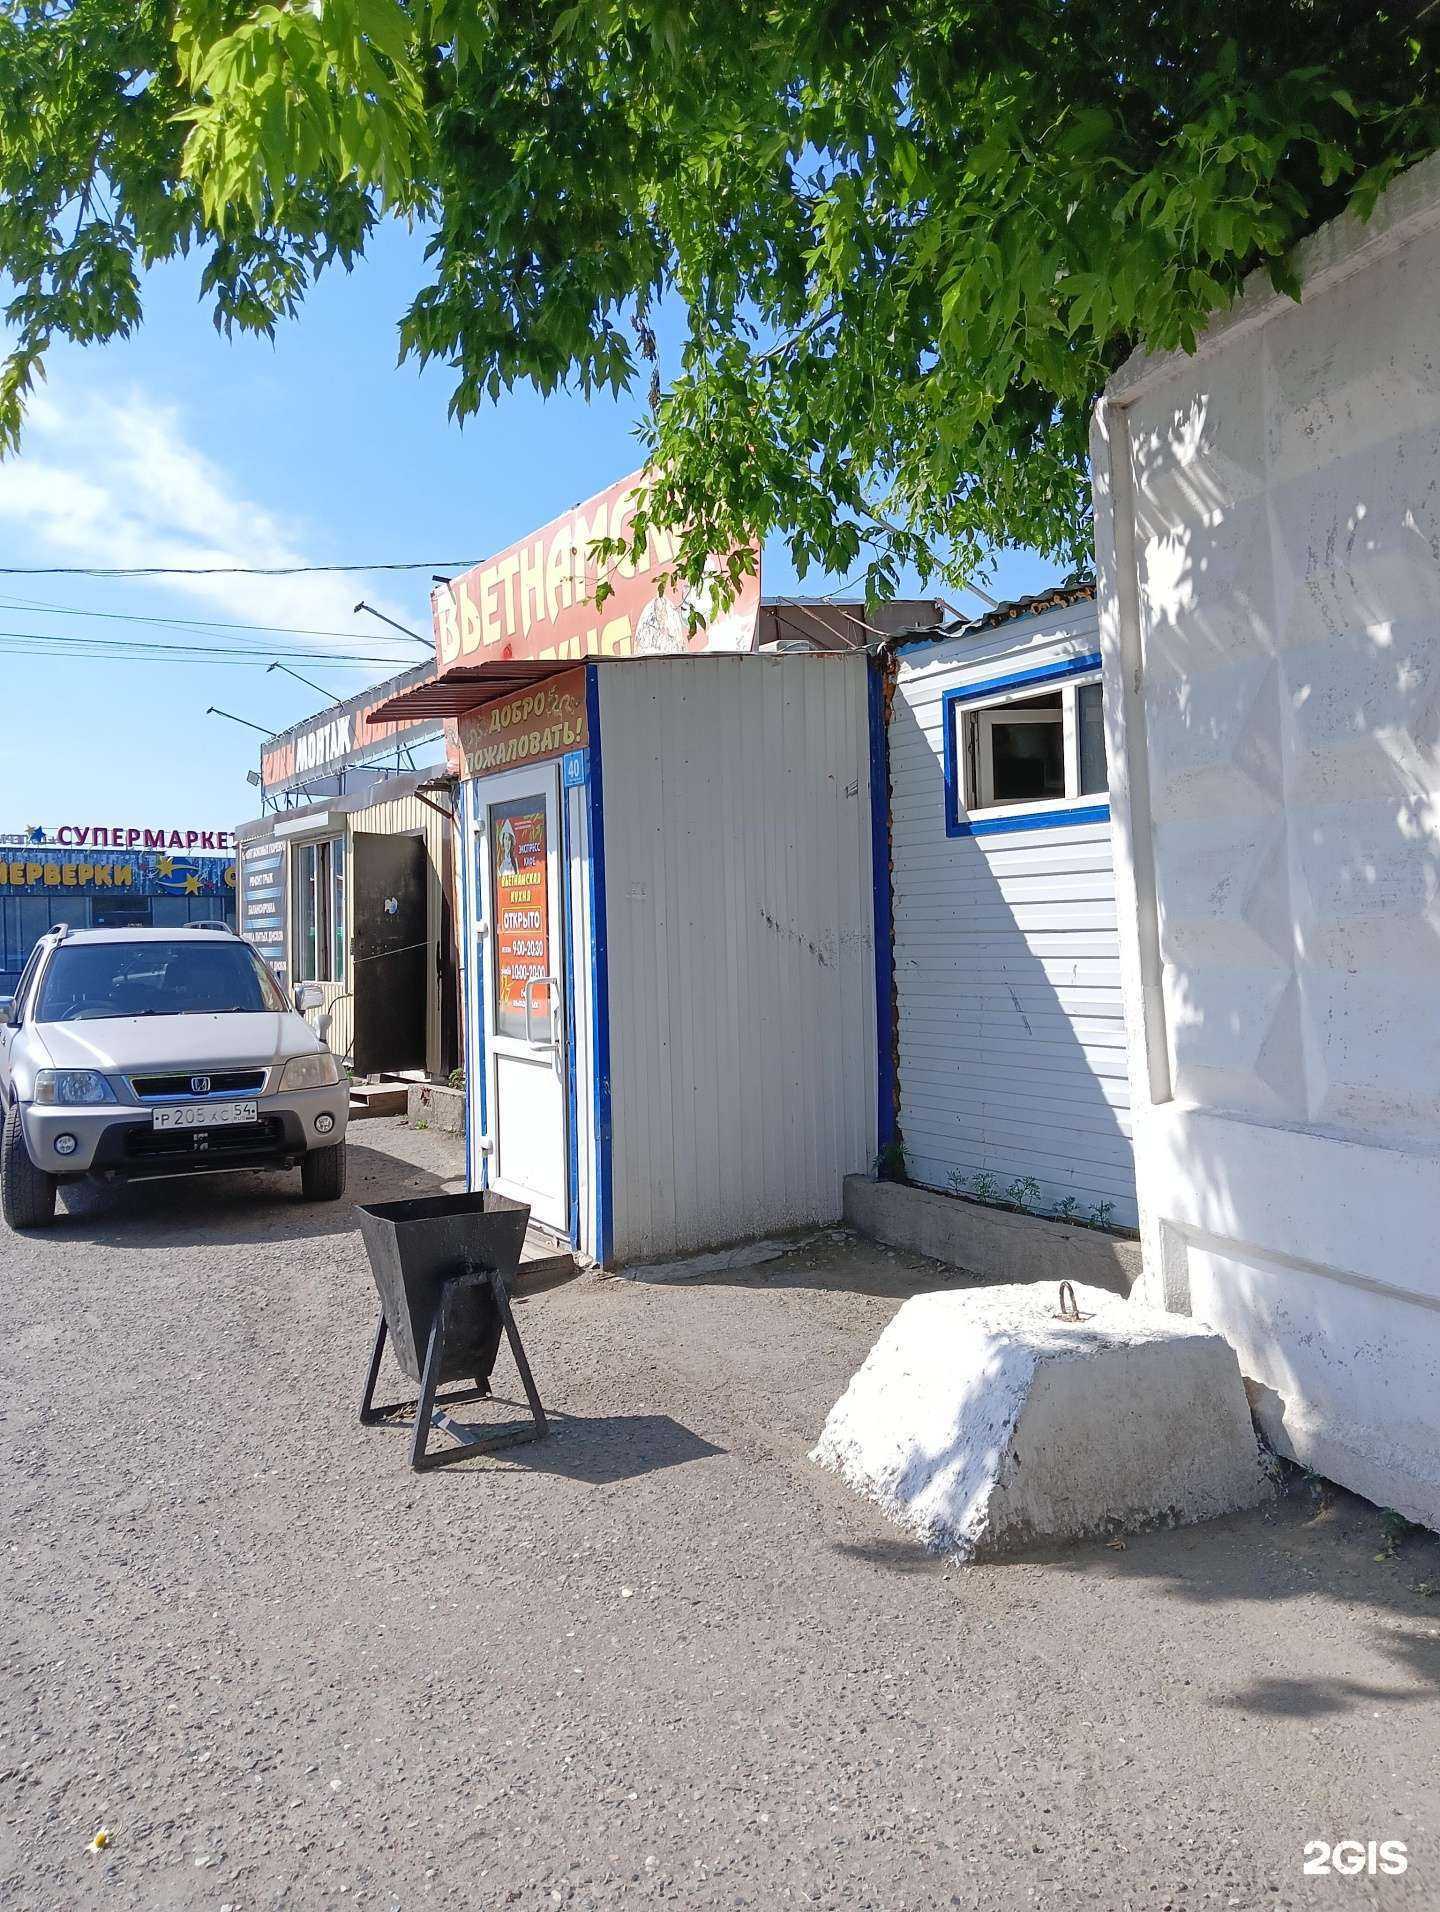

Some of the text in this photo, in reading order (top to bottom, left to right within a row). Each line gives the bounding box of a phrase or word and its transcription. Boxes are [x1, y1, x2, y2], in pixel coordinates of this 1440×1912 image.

[489, 692, 546, 734] ДОБРО
[465, 717, 583, 774] ПОЖАЛОВАТЬ!
[568, 759, 580, 778] 40
[510, 890, 531, 903] КУХНЯ
[503, 910, 541, 930] ОТКРЫТО
